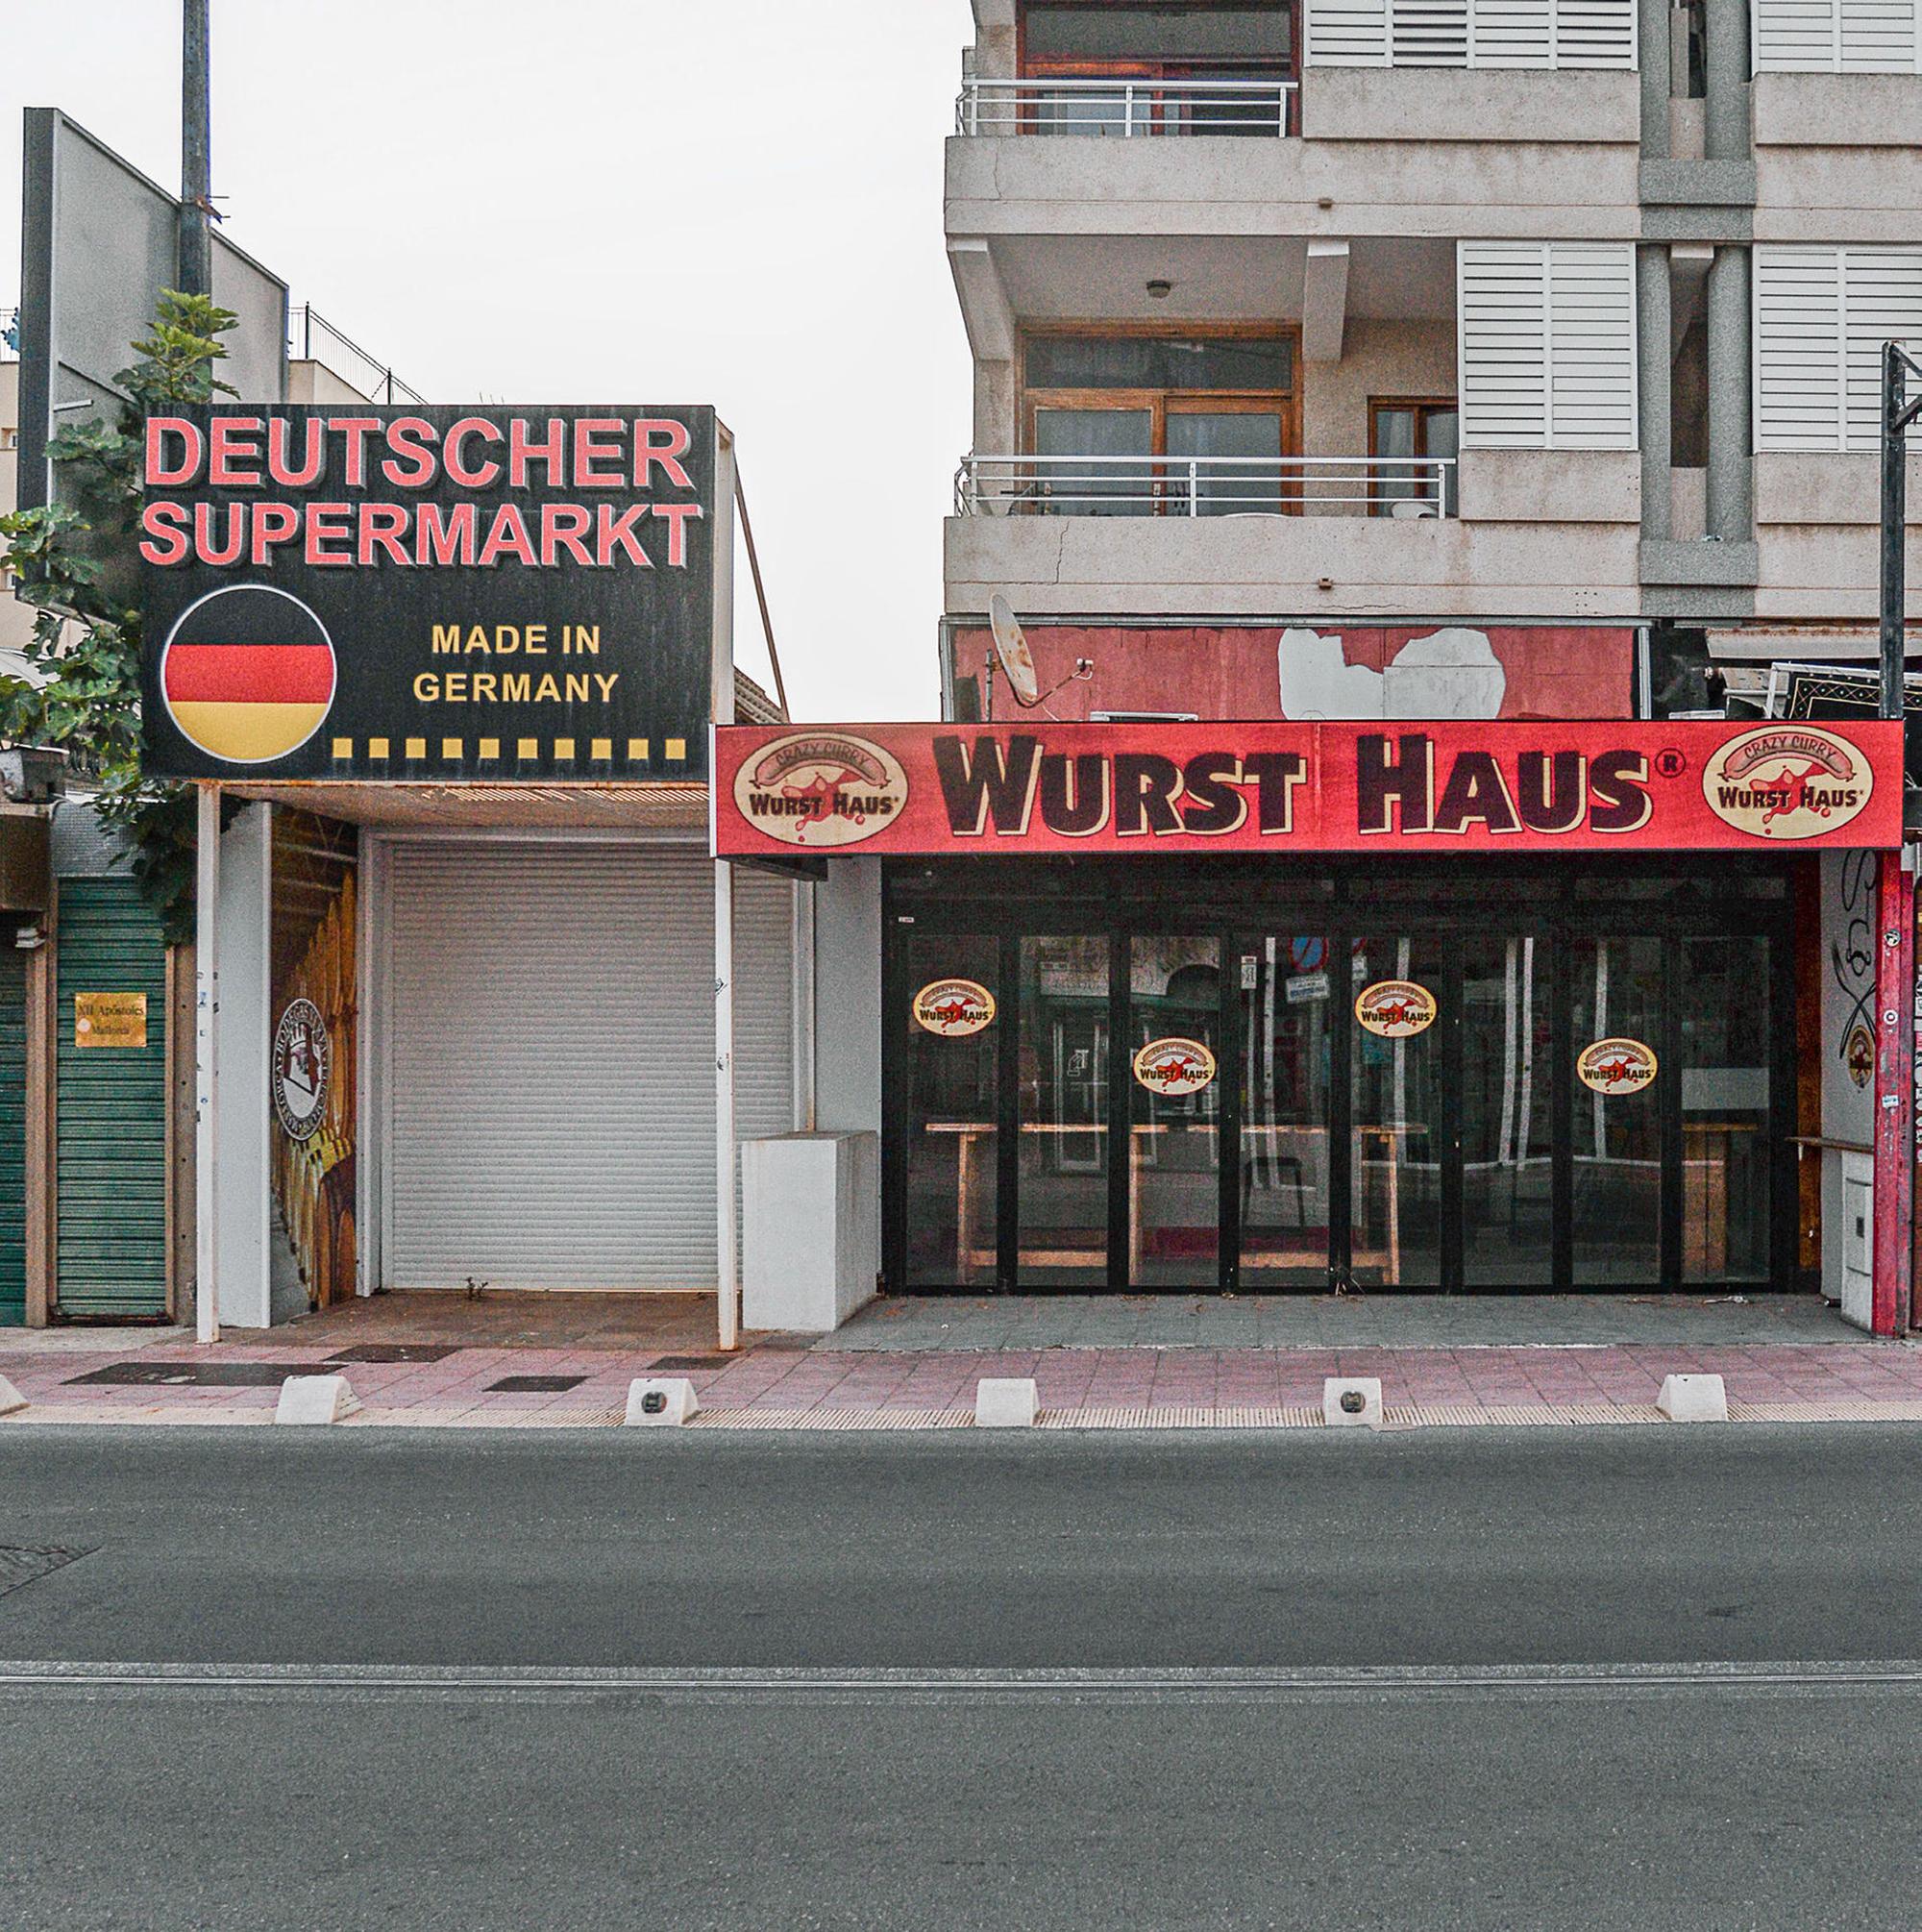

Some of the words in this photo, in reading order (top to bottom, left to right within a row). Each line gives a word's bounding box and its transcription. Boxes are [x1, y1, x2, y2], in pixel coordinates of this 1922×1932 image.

[145, 416, 696, 488] DEUTSCHER
[138, 502, 704, 568] SUPERMARKT
[431, 625, 548, 655] MADE
[562, 625, 600, 655] IN
[413, 672, 619, 704] GERMANY
[776, 743, 821, 768] CRAZY
[825, 742, 872, 768] CURRY
[1743, 735, 1788, 760] CRAZY
[1790, 734, 1837, 760] CURRY
[931, 734, 1308, 837] WURST
[1717, 786, 1791, 809] WURST
[749, 793, 823, 816] WURST
[919, 1009, 954, 1022] WURST
[1360, 1011, 1396, 1023] WURST
[1140, 1069, 1175, 1080] WURST
[1583, 1069, 1618, 1080] WURST
